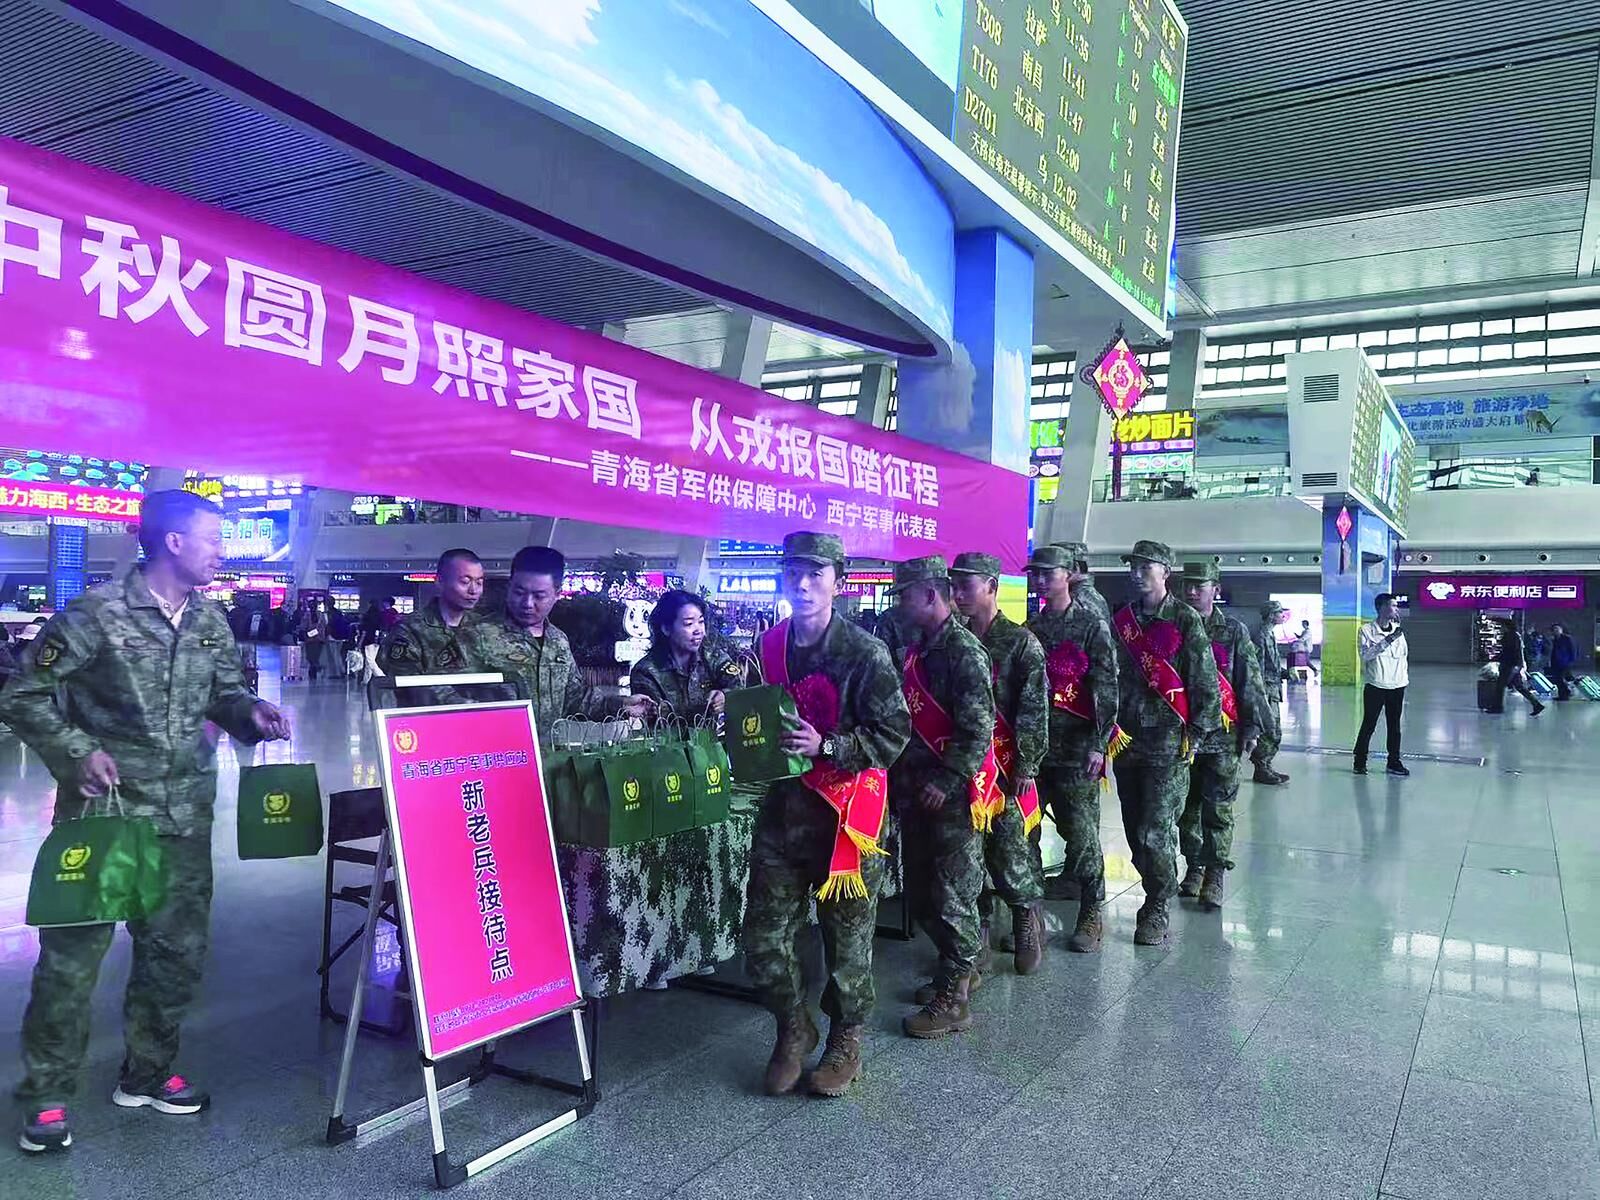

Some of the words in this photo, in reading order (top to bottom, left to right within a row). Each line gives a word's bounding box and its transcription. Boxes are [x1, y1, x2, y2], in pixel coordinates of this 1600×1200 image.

[972, 44, 999, 91] T176
[1012, 84, 1046, 139] 北京西
[1056, 134, 1080, 174] 12:00
[976, 0, 1003, 46] T308
[1022, 49, 1044, 93] 南昌
[1059, 95, 1083, 136] 11:47
[1063, 56, 1086, 101] 11:41
[1126, 136, 1134, 158] 2
[1065, 17, 1090, 63] 11:35
[1129, 102, 1138, 128] 10
[1131, 68, 1141, 93] 12
[964, 85, 998, 138] D2701
[1052, 172, 1077, 212] 12:02
[0, 184, 643, 440] 中秋圆月照家国
[689, 396, 939, 507] 从戎报国踏征程
[827, 498, 937, 541] 西宁军事代表室
[1460, 585, 1542, 598] 京东便利店
[460, 779, 514, 984] 新老兵接待点
